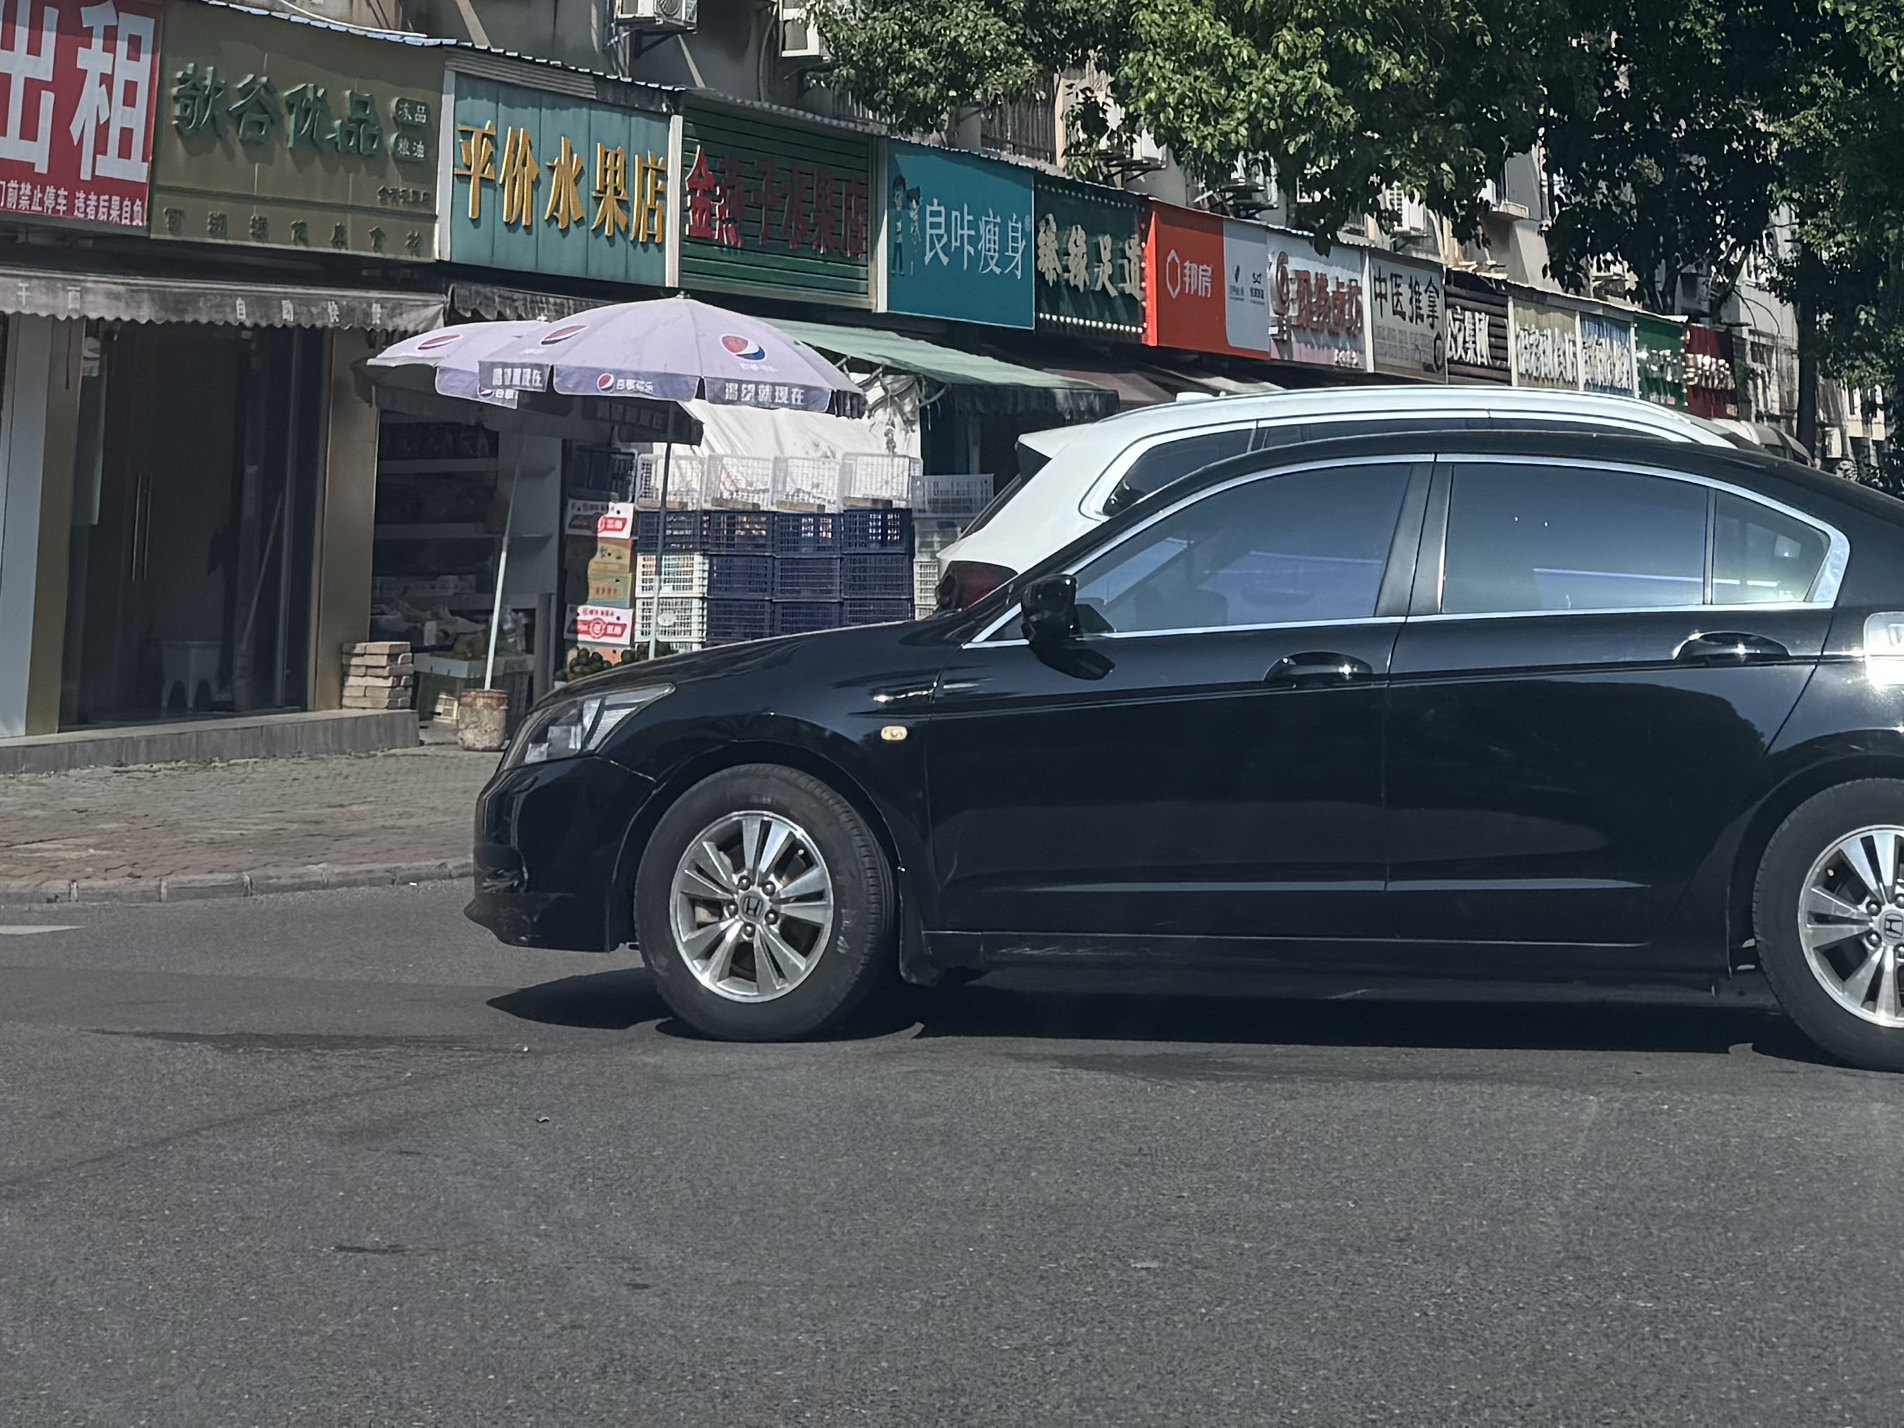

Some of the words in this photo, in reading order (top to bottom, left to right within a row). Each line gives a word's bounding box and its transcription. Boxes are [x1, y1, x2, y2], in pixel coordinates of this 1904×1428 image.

[73, 190, 144, 227] 违者后果自负
[456, 121, 667, 244] 平价水果店
[685, 144, 867, 258] 金燕子水果店
[924, 197, 1026, 280] 良咔瘦身
[1373, 266, 1440, 331] 中医推拿
[725, 382, 805, 405] 渴望就现在
